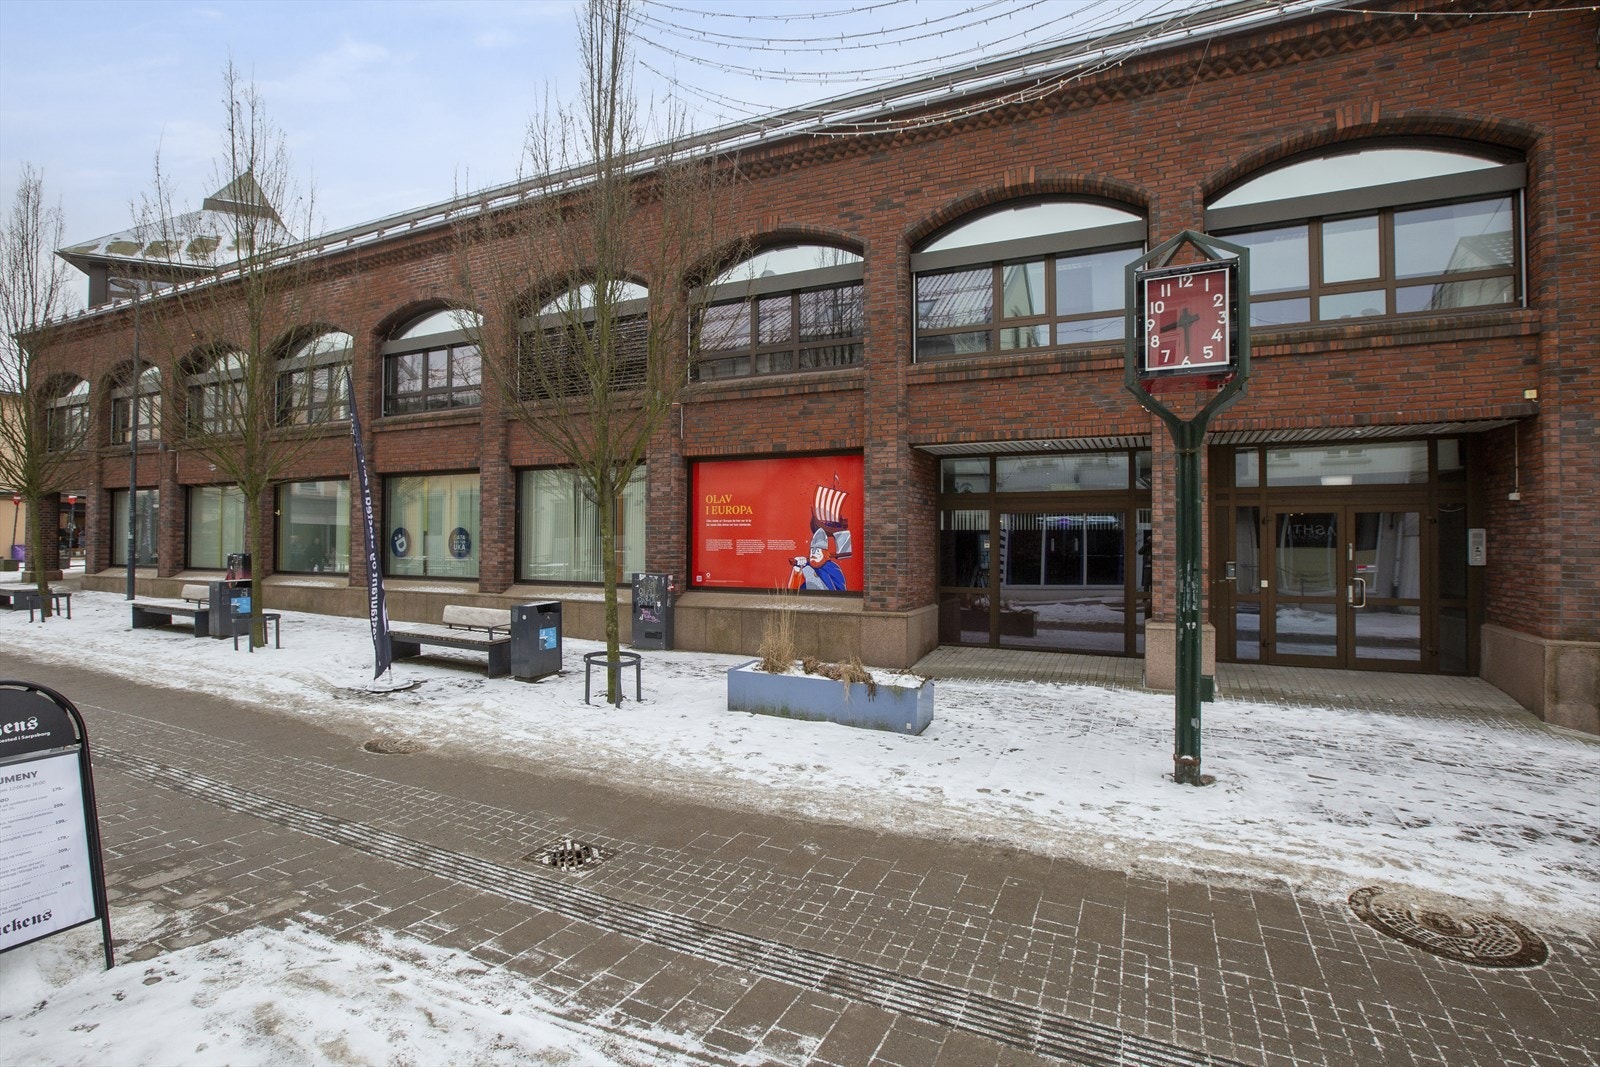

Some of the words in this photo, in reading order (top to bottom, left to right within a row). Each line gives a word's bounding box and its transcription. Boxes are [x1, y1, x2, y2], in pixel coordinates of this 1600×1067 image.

[1179, 275, 1193, 288] 12
[1205, 279, 1209, 292] 1
[1161, 284, 1171, 297] 11
[1213, 294, 1223, 307] 2
[1150, 301, 1164, 315] 10
[1217, 311, 1226, 324] 3
[1147, 319, 1155, 331] 9
[1150, 335, 1160, 348] 8
[1211, 329, 1223, 342] 4
[1161, 350, 1170, 363] 7
[1203, 346, 1213, 359] 5
[1181, 356, 1191, 366] 6
[705, 494, 732, 504] OLAV
[706, 506, 709, 515] I
[711, 505, 753, 515] EUROPA
[21, 731, 51, 740] Sarpsborg
